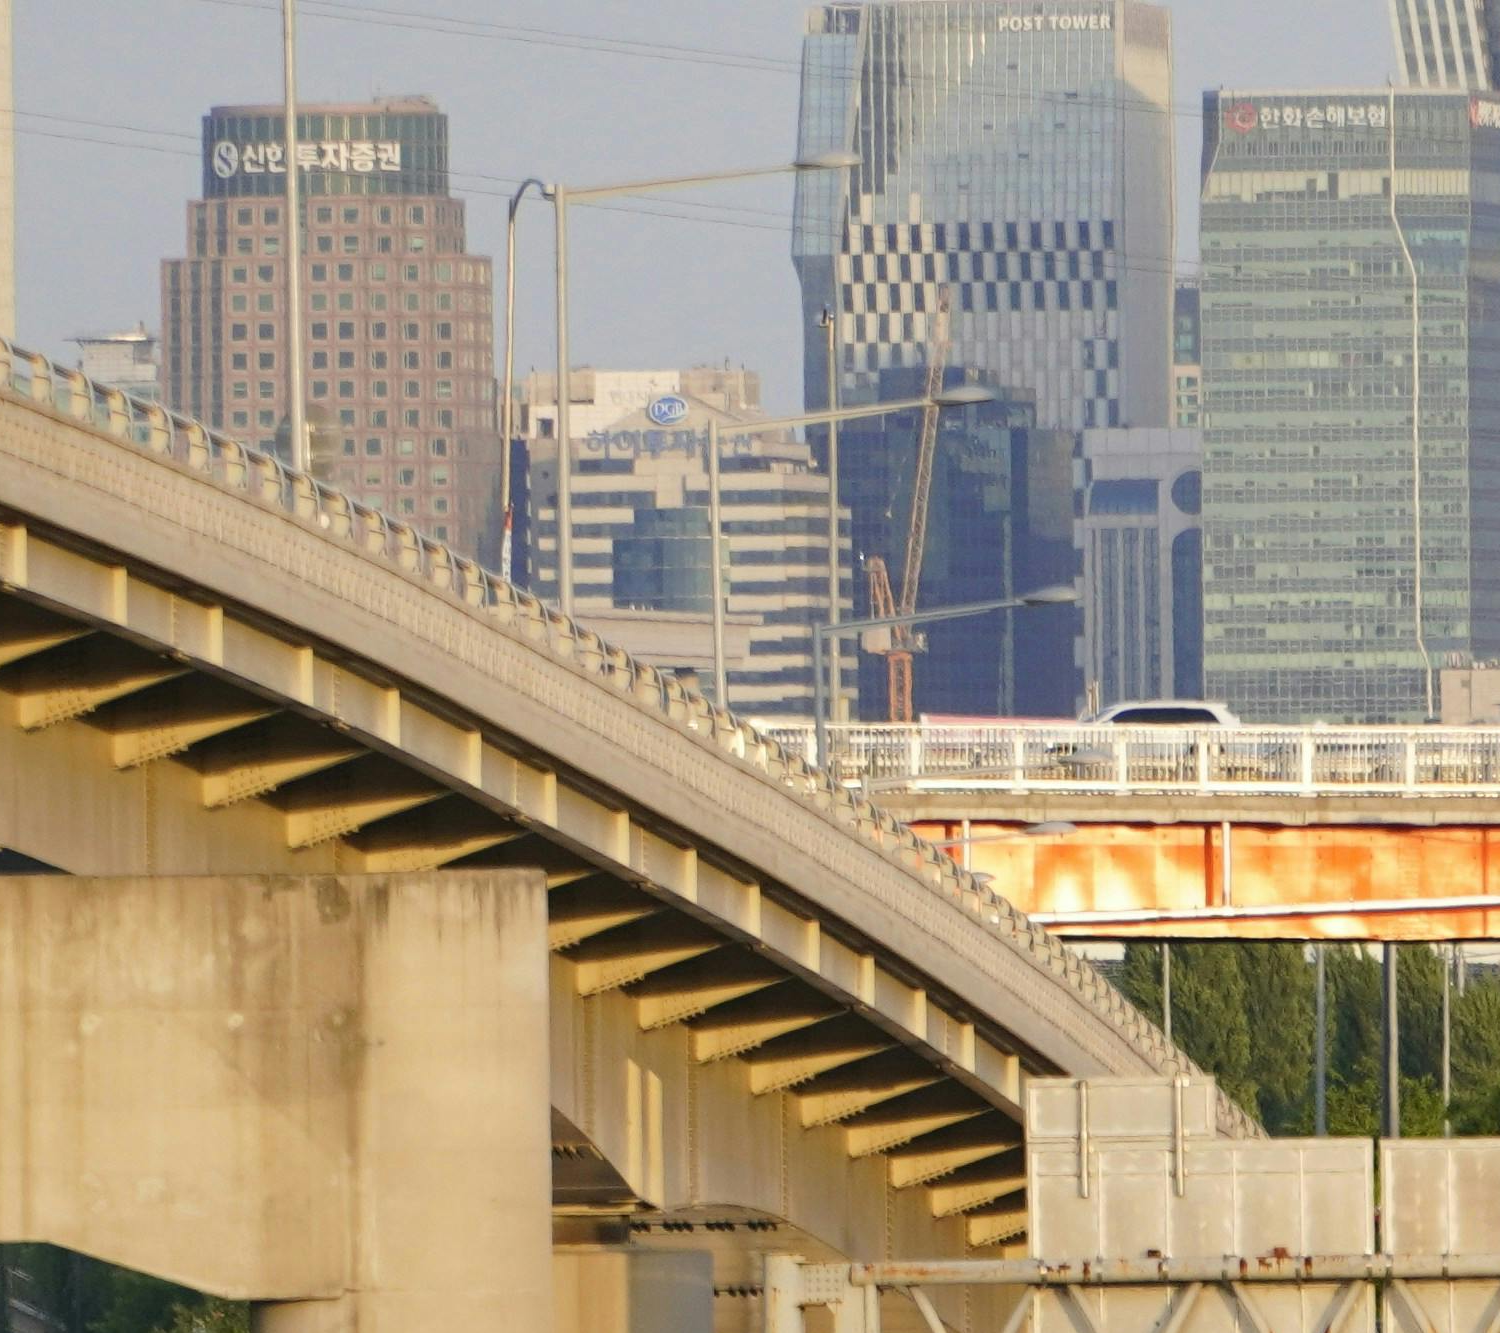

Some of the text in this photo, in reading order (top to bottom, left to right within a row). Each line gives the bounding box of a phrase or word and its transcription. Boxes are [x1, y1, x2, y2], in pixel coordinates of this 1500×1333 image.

[999, 14, 1111, 31] POST TOWER
[1261, 104, 1386, 128] 한화손해보험
[243, 143, 401, 173] 신한투자증권
[654, 402, 685, 417] DGB
